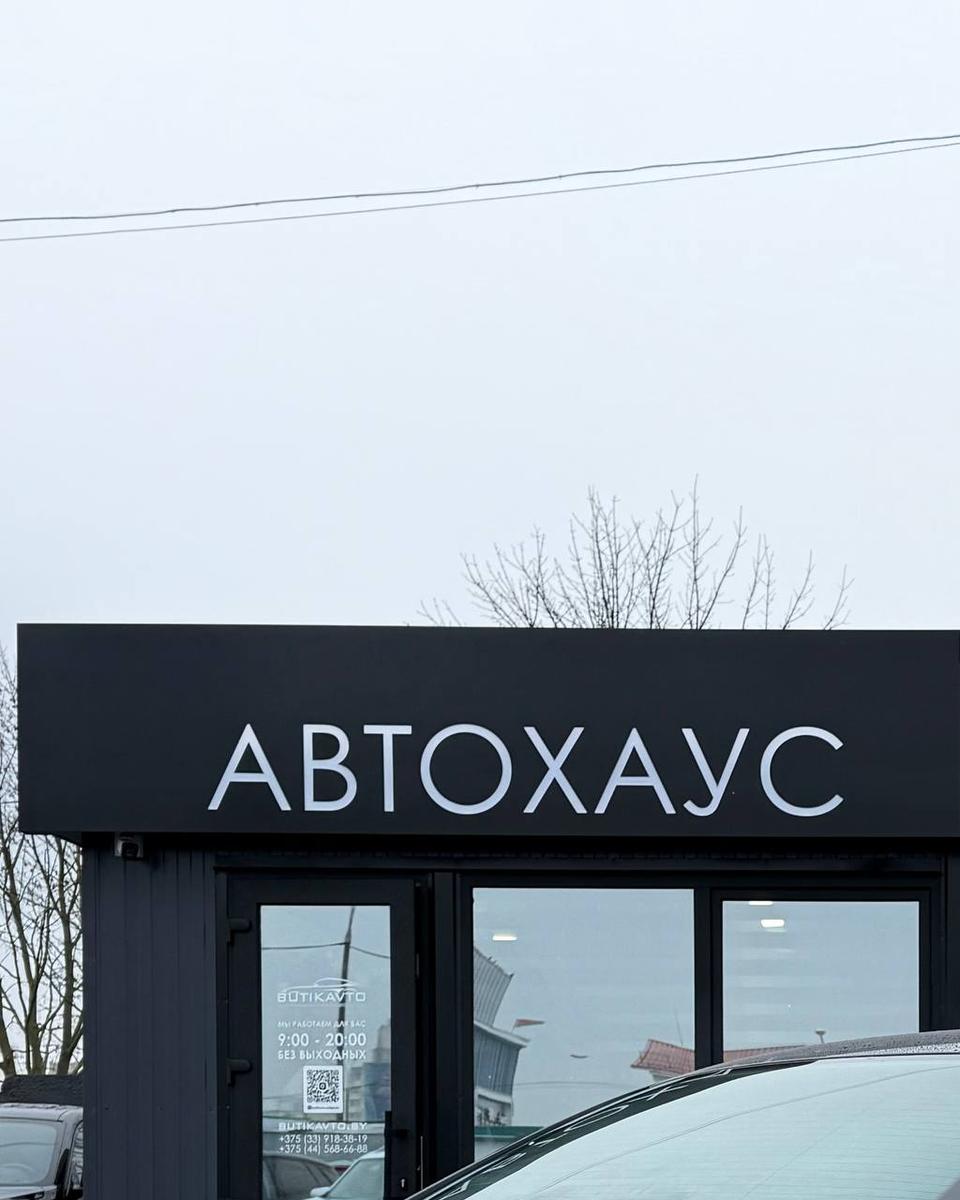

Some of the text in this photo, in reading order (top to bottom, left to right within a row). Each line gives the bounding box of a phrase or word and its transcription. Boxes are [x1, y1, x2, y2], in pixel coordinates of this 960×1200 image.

[208, 723, 844, 818] АВТОХАУС
[277, 991, 367, 1003] BUTIKAVTO
[278, 1033, 309, 1047] 9:00
[325, 1032, 367, 1047] 20:00
[278, 1049, 367, 1061] БЕЗ ВЫХОДНЫХ
[278, 1122, 368, 1131] BUTIKAVTO.BY
[280, 1134, 368, 1146] +375 (33) 918-38-19
[280, 1144, 368, 1156] +375 (44) 568-66-88
